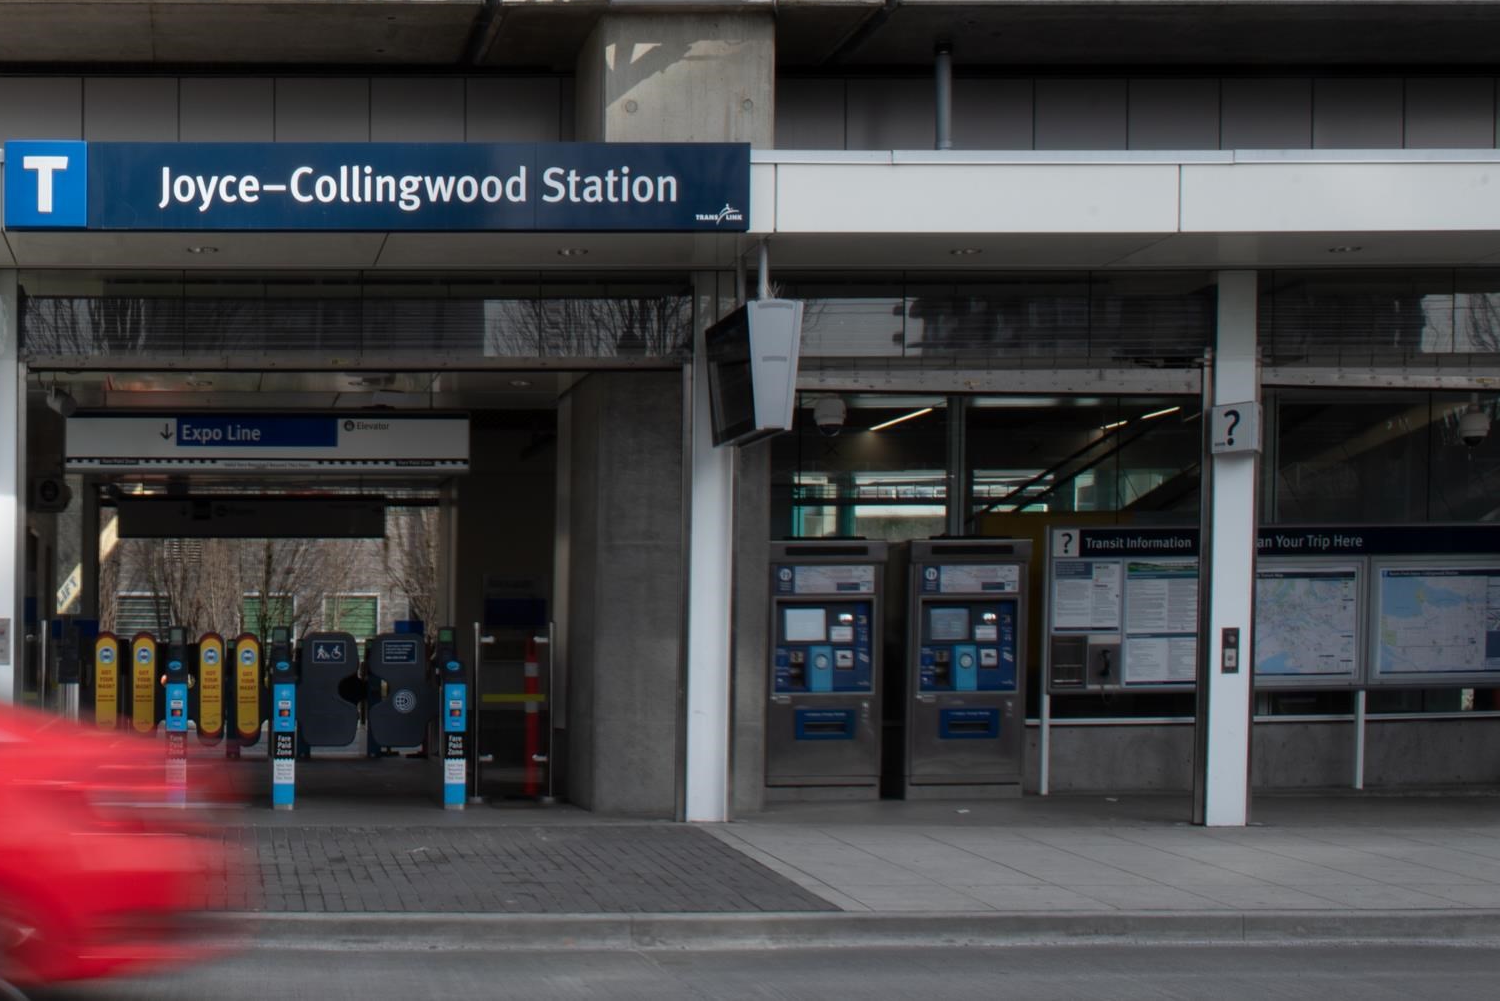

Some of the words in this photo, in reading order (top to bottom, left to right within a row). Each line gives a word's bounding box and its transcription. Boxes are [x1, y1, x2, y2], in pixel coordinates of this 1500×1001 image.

[23, 156, 69, 213] T
[542, 165, 677, 203] Station
[183, 424, 222, 444] Expo
[228, 425, 261, 440] Line
[356, 421, 390, 431] Elevator
[1085, 537, 1124, 549] Transit
[1126, 536, 1192, 549] Information
[1257, 538, 1272, 548] an
[1276, 536, 1304, 548] Your
[1306, 535, 1330, 550] Trip
[1333, 535, 1363, 548] Here
